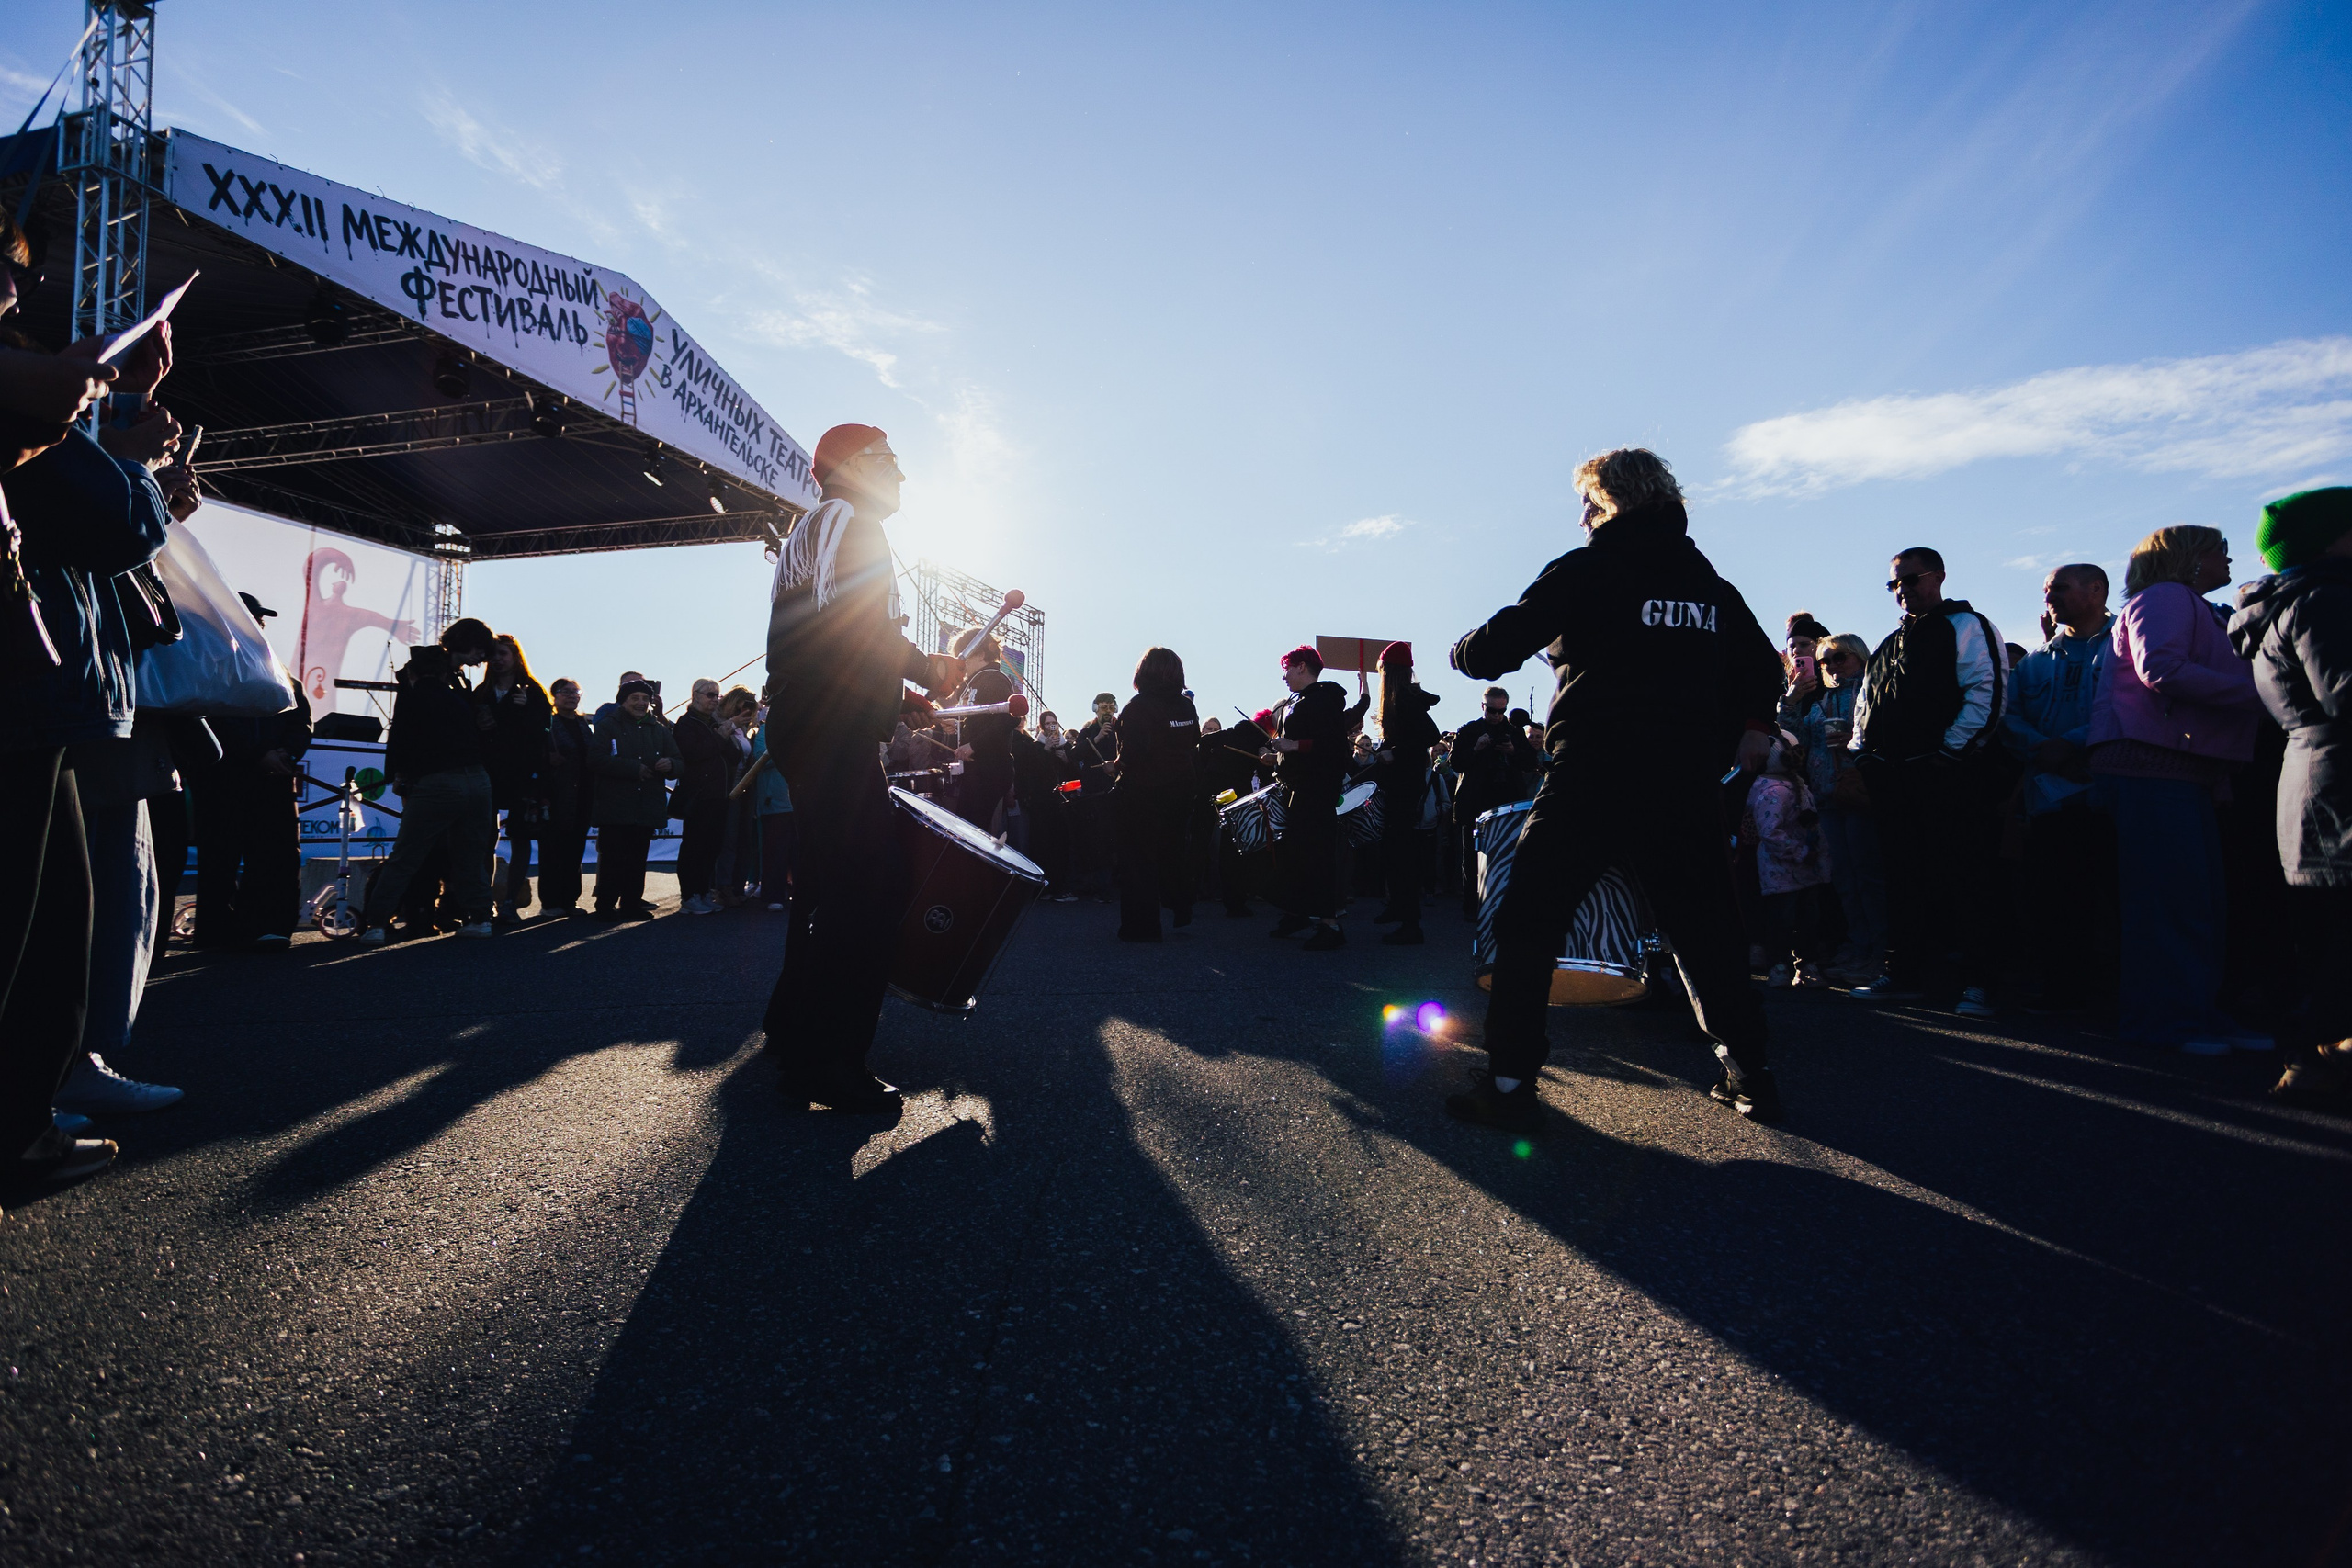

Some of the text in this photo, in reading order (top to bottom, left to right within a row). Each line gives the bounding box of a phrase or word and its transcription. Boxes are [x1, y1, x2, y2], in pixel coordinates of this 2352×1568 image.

[201, 163, 600, 310] XXXII МЕЖДУНАРОДНЫЙ
[401, 266, 588, 347] ФЕСТИВАЛЬ
[660, 364, 778, 490] В АРХАНГЕЛЬСКЕ
[670, 328, 765, 445] УЛИЧНЫХ
[1641, 599, 1716, 633] GUNA
